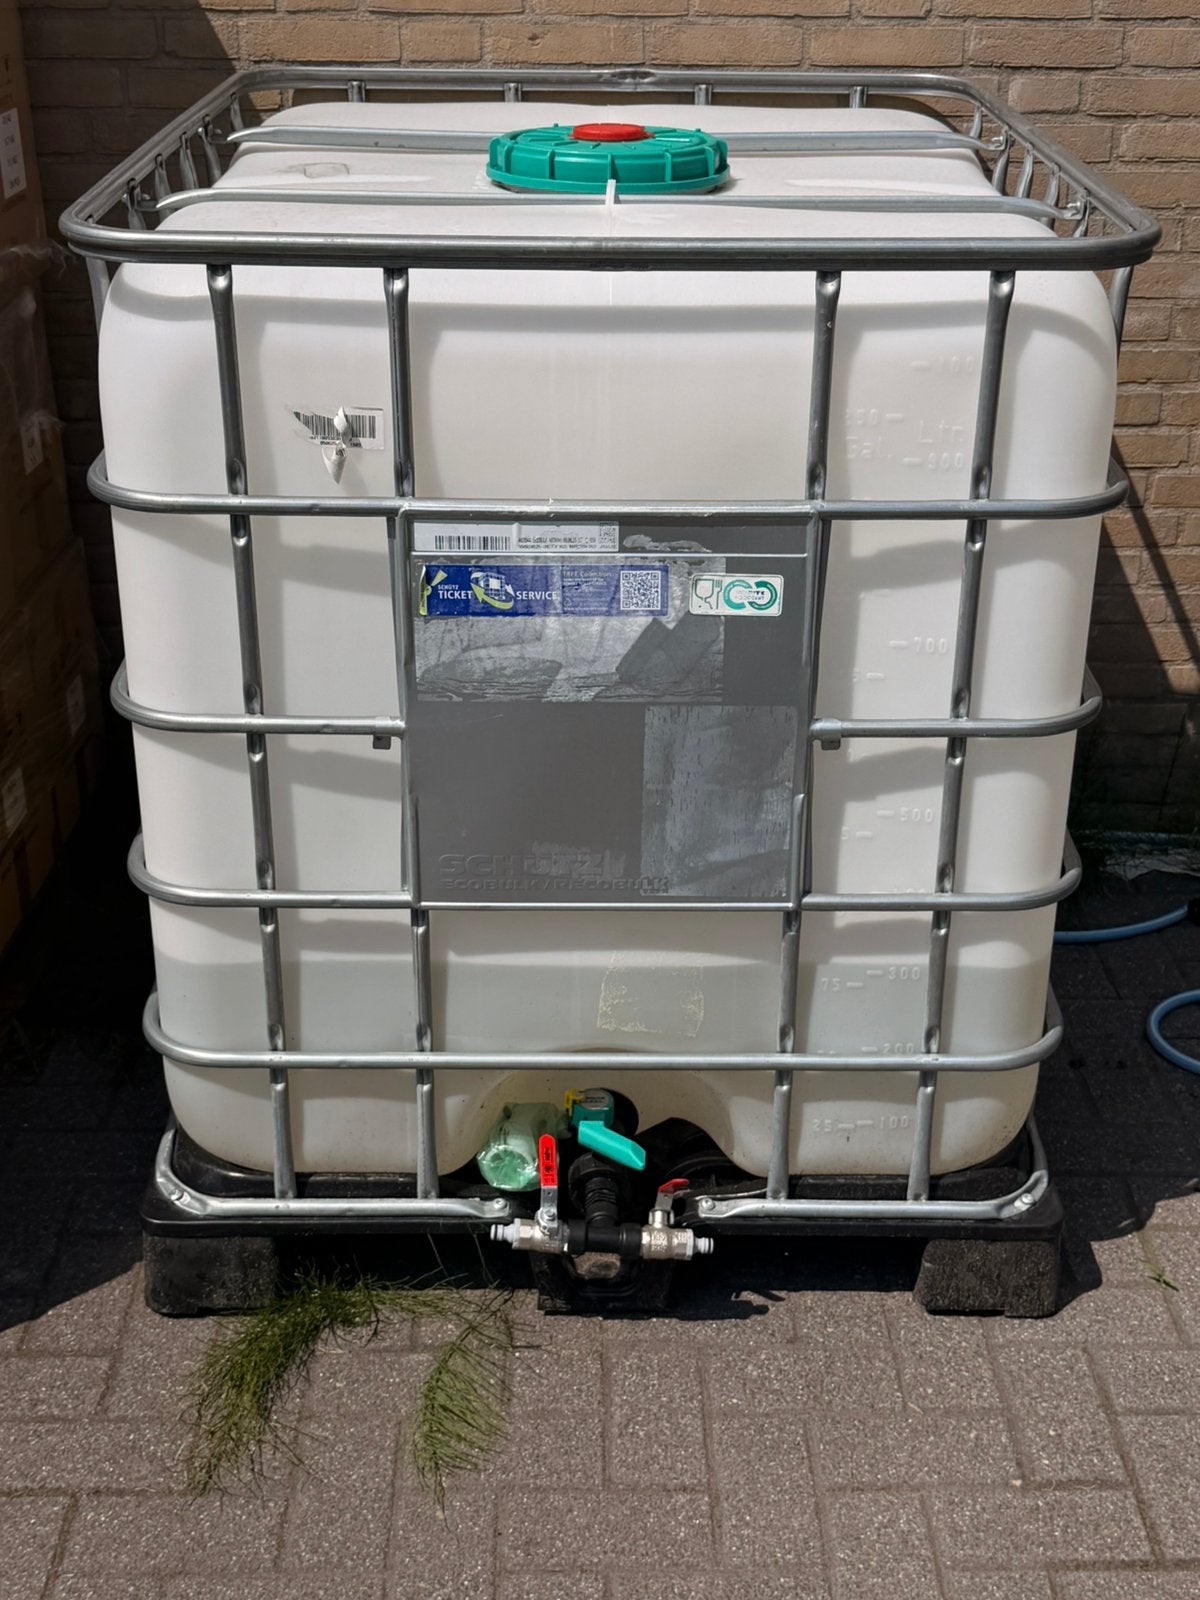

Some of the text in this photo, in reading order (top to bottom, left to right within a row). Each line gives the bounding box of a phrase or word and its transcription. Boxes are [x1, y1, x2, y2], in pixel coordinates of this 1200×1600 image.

[928, 452, 965, 471] 900
[438, 590, 559, 601] TICKET SERVICE
[914, 635, 949, 654] 700
[899, 806, 935, 823] 500
[888, 966, 921, 981] 300
[819, 977, 841, 992] 75
[812, 1118, 833, 1133] 25
[880, 1114, 909, 1130] 100
